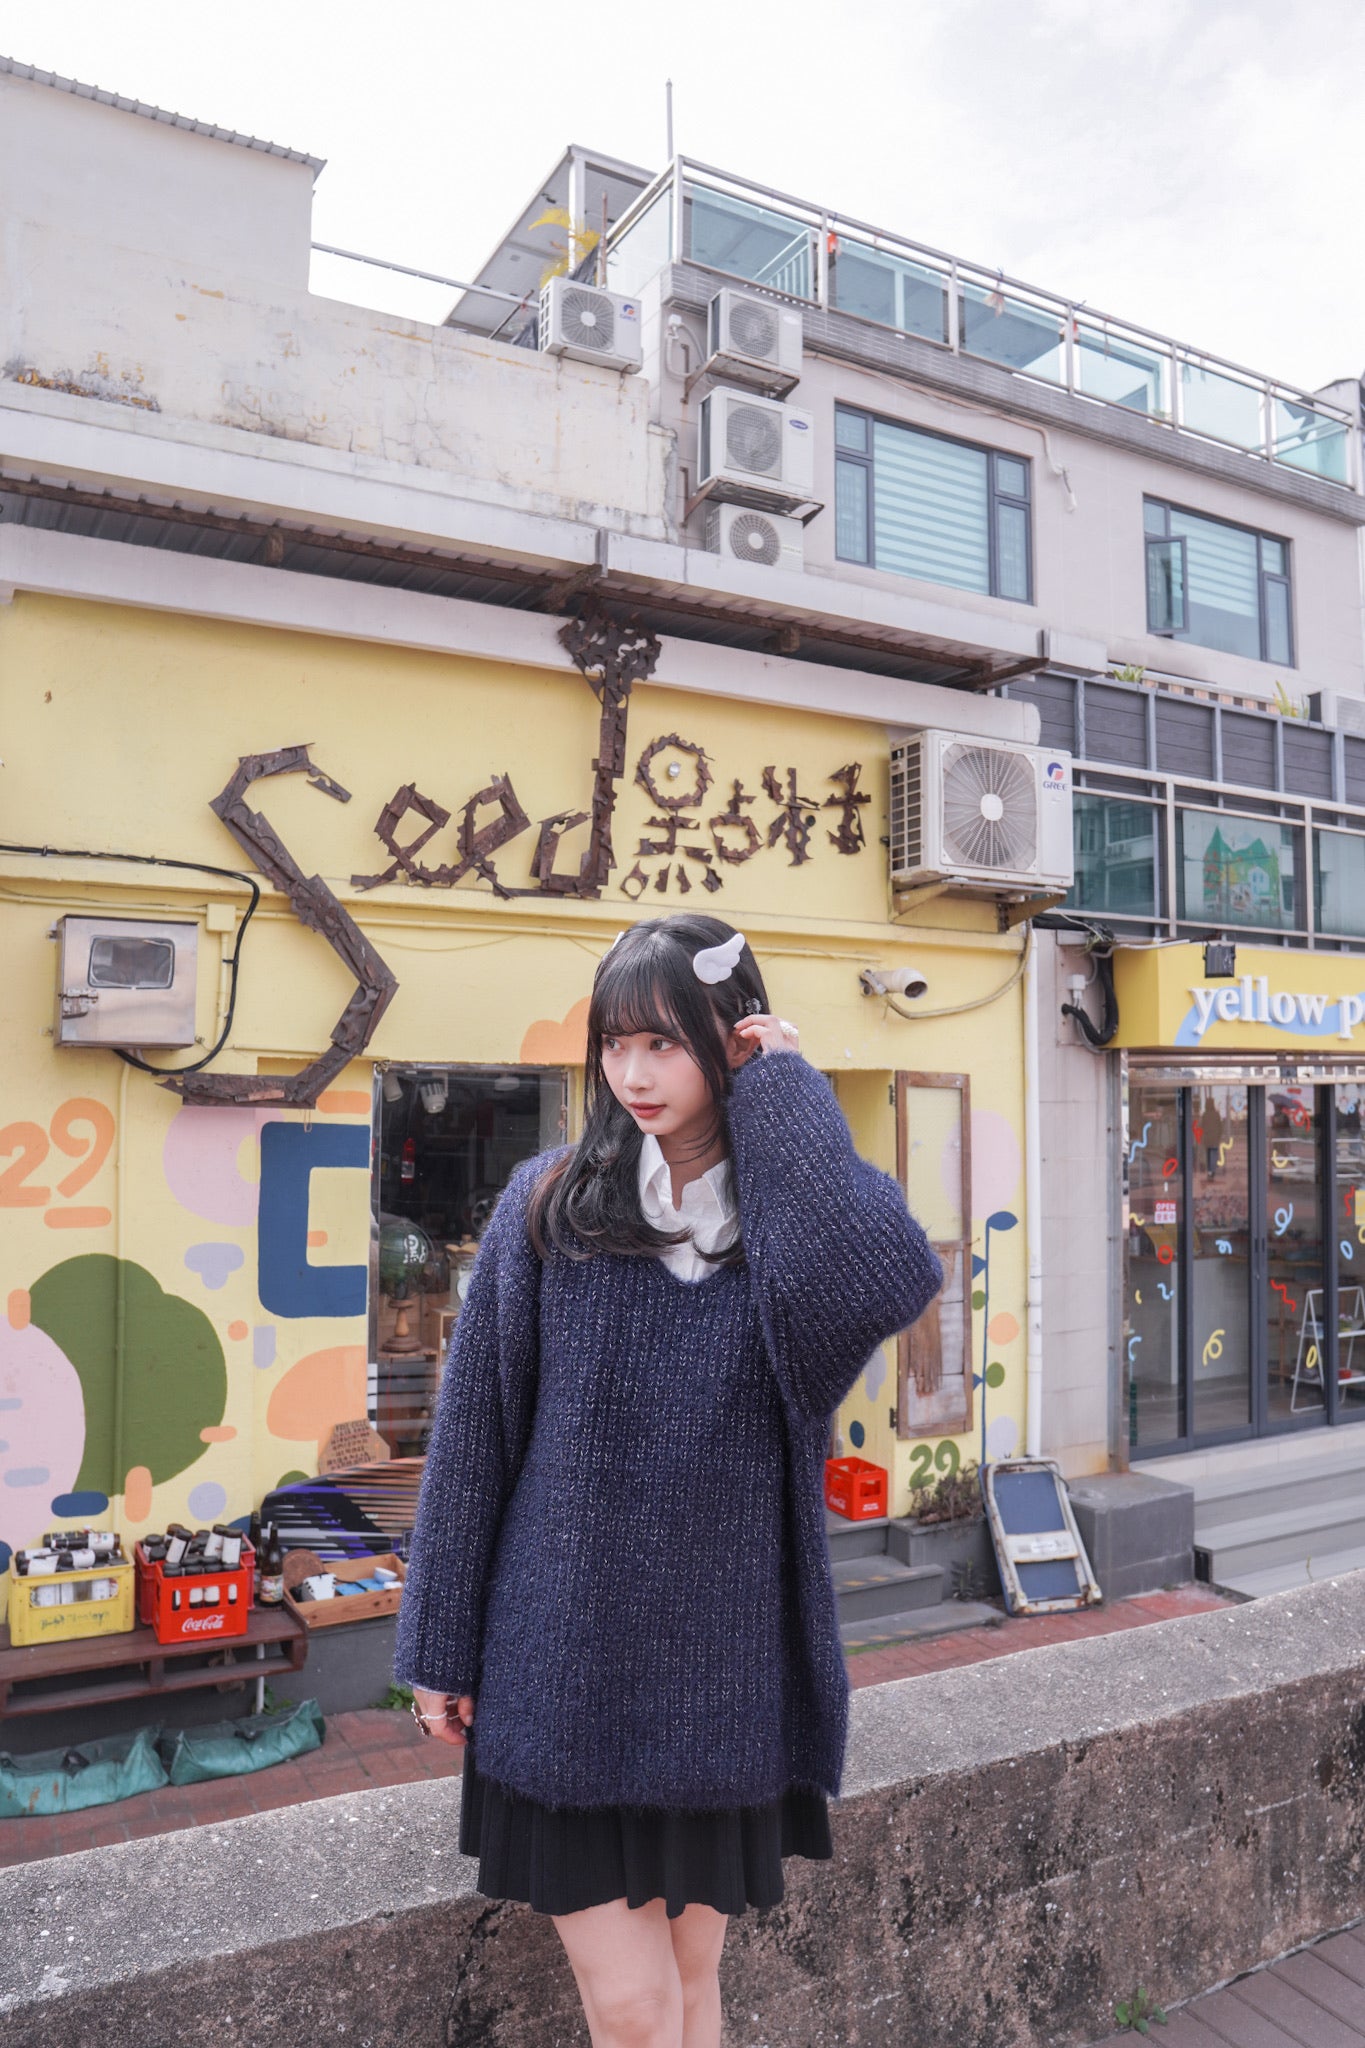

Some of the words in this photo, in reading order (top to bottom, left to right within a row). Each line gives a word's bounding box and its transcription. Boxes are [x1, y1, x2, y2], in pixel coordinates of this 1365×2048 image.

[155, 613, 662, 1109] Seed
[1188, 974, 1328, 1036] yellow
[1337, 994, 1365, 1040] p
[0, 1097, 115, 1207] 29
[1156, 1202, 1176, 1210] OPEN
[909, 1439, 960, 1489] 29
